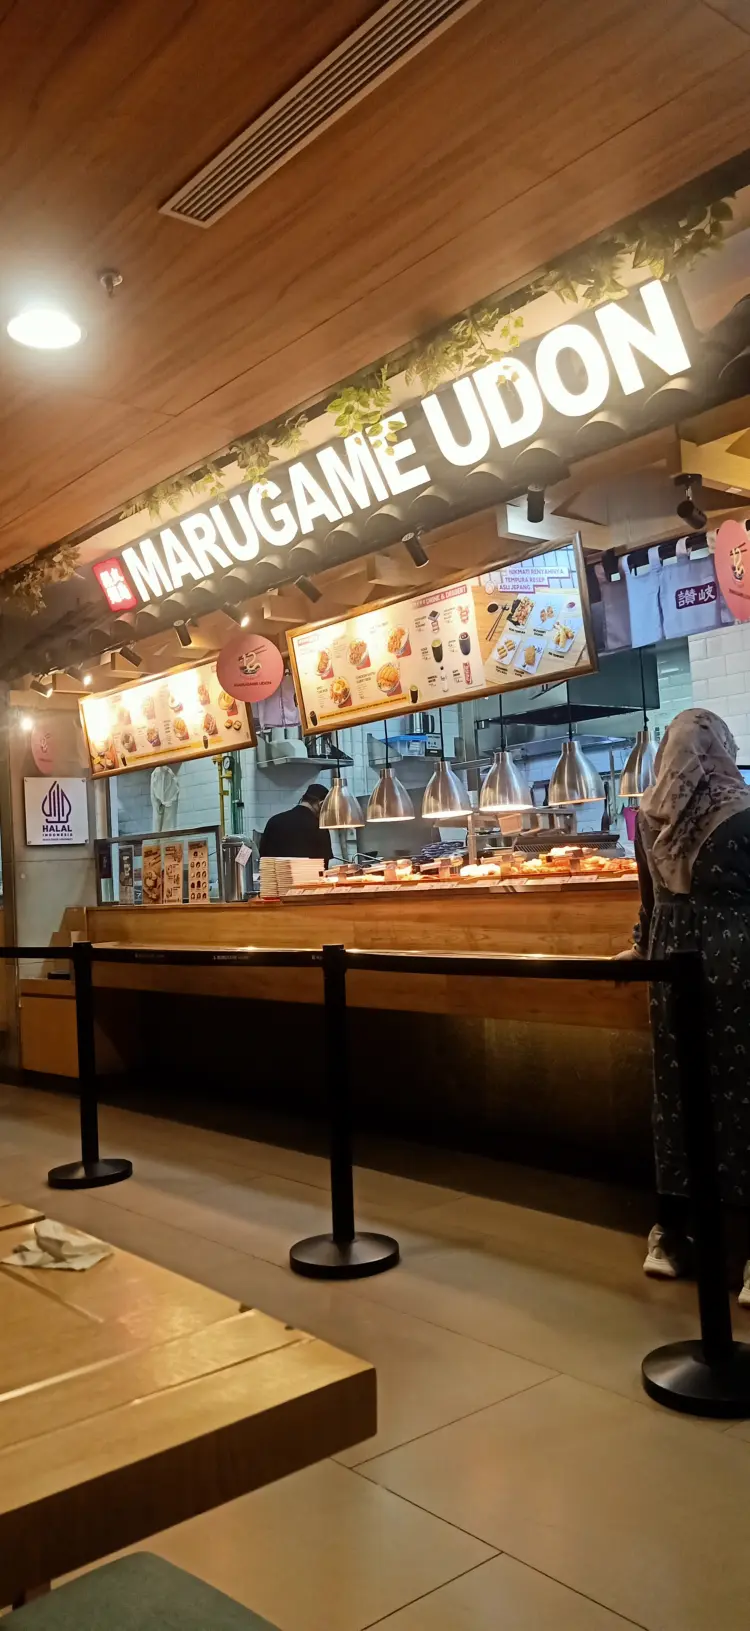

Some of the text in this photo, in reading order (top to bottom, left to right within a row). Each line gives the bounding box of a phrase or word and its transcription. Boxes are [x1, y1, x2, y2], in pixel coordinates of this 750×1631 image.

[121, 279, 692, 603] MARUGAME UDON
[42, 824, 73, 832] HALAL
